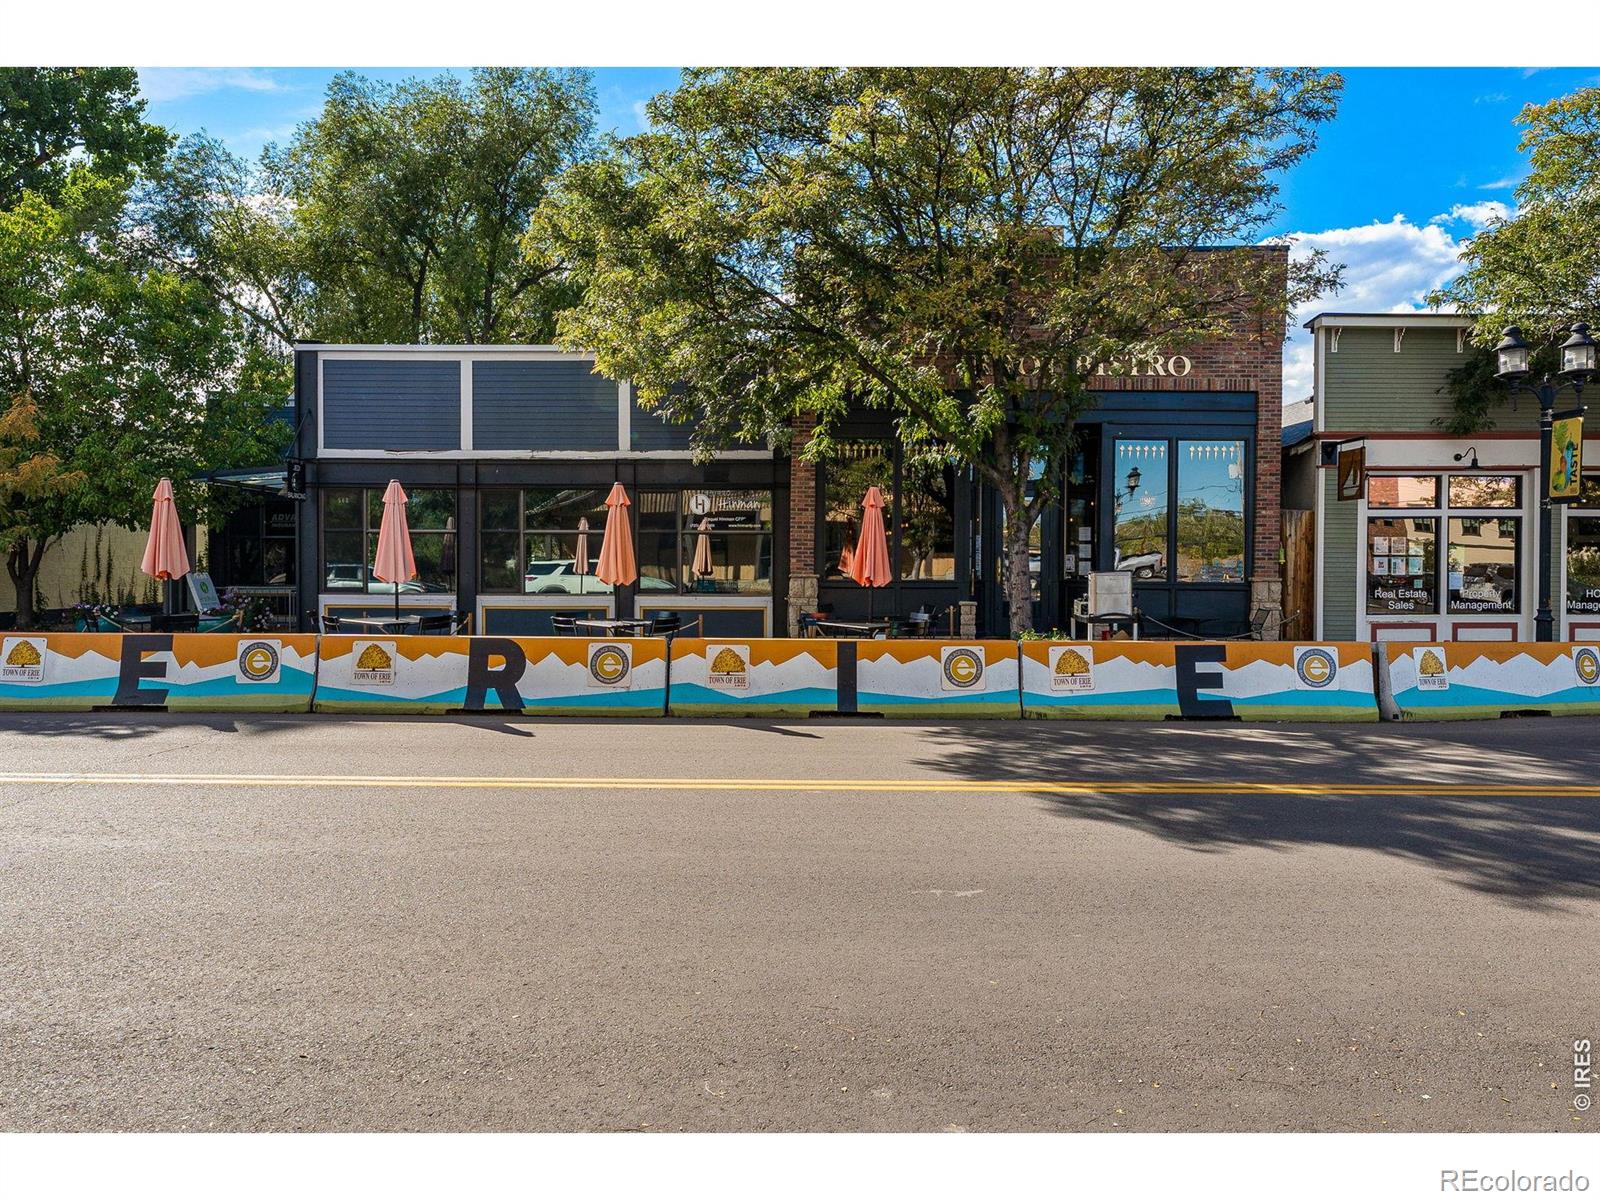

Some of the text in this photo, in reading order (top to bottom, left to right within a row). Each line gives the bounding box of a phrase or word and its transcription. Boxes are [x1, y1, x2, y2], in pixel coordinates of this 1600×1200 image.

[1570, 443, 1579, 486] TASTE
[719, 498, 761, 510] Hinman
[1374, 589, 1428, 599] Real Estate
[1462, 589, 1502, 600] Property
[1388, 600, 1415, 610] Sales
[1450, 600, 1512, 611] Management
[1567, 600, 1600, 612] Manag
[28, 669, 40, 677] ERIE
[112, 634, 174, 704] E
[463, 638, 526, 709] R
[837, 641, 857, 712] I
[1175, 645, 1234, 716] E
[354, 672, 391, 681] TOWN OF ERIE
[709, 676, 746, 684] TOWN OF ERIE
[1053, 677, 1091, 686] TOWN OF ERIE
